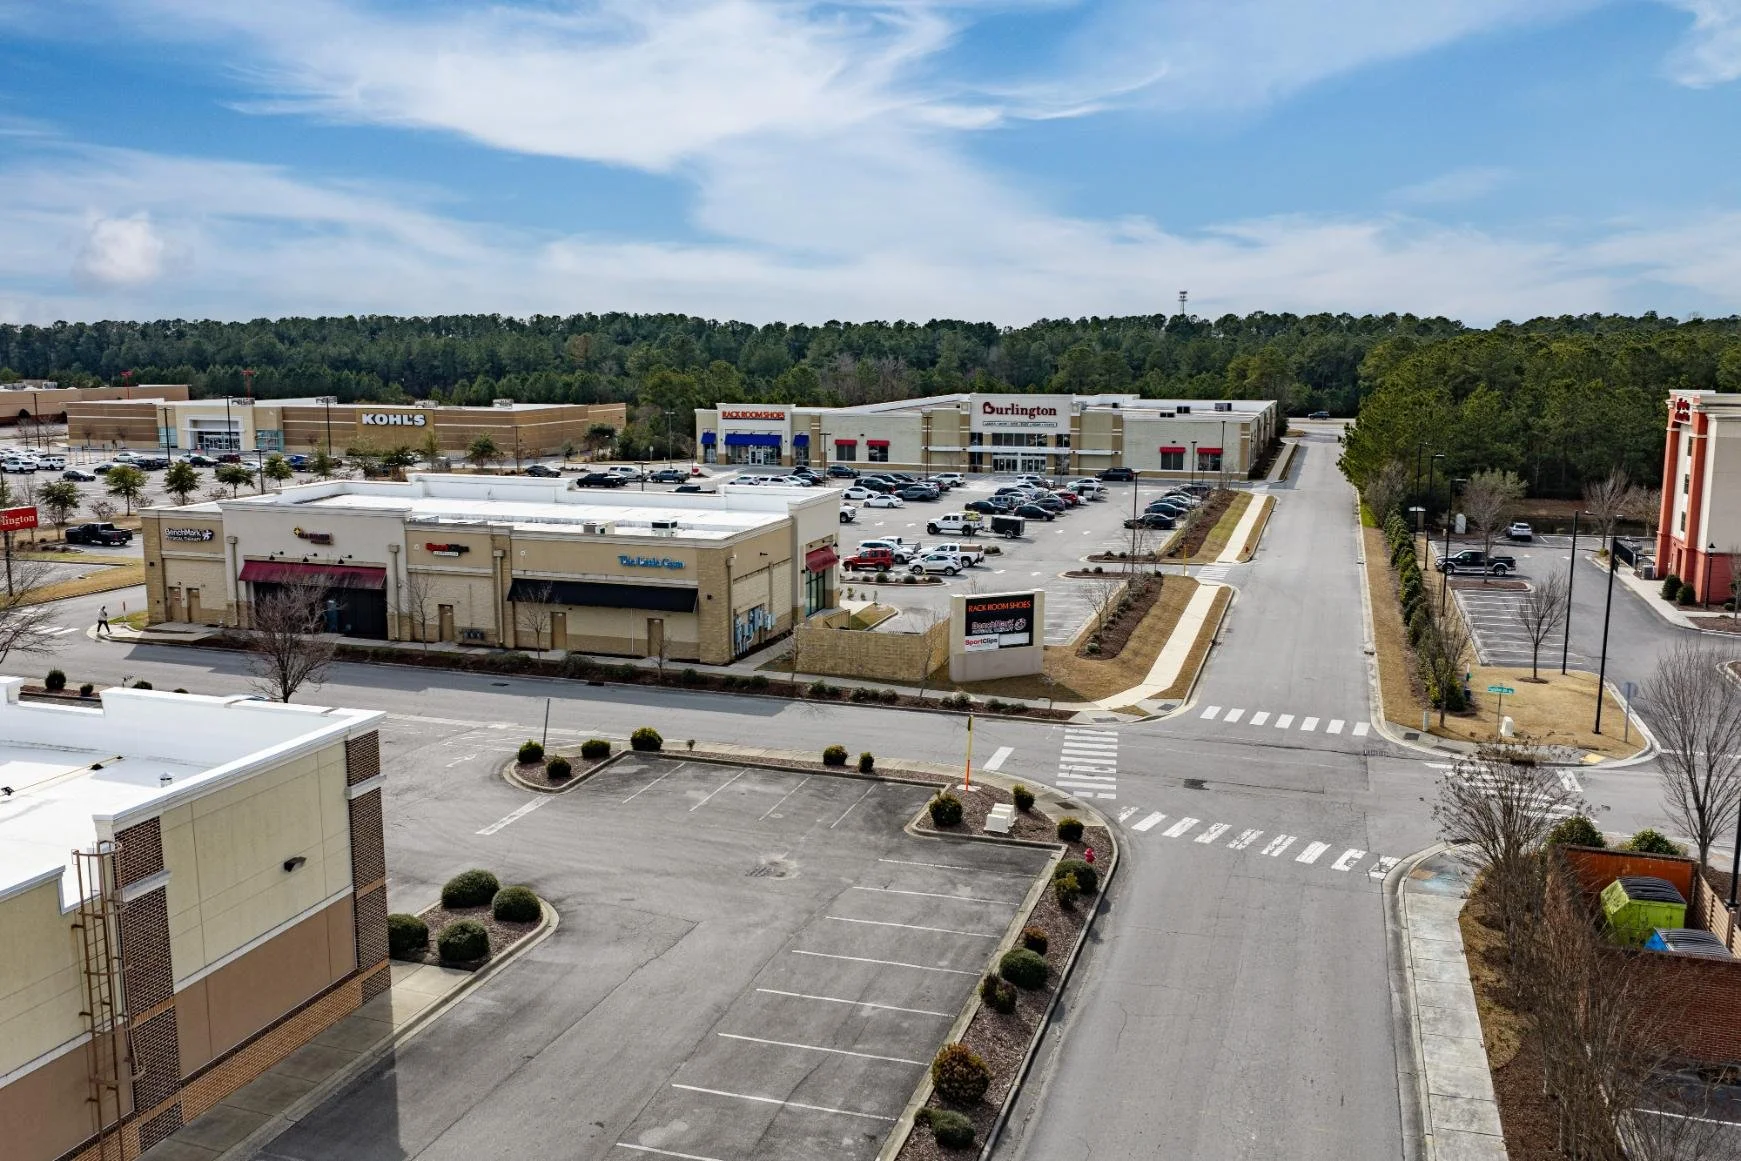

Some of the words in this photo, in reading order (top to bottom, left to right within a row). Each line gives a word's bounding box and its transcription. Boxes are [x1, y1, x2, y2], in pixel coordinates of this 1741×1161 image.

[722, 411, 740, 420] RACK
[741, 411, 762, 420] ROOM
[763, 411, 785, 420] SHOES
[983, 402, 1057, 419] Burlington
[362, 413, 425, 426] KOHL'S
[164, 527, 202, 537] BenchMark
[968, 603, 986, 612] RACK
[987, 602, 1008, 611] ROOM
[1010, 600, 1031, 609] SHOES
